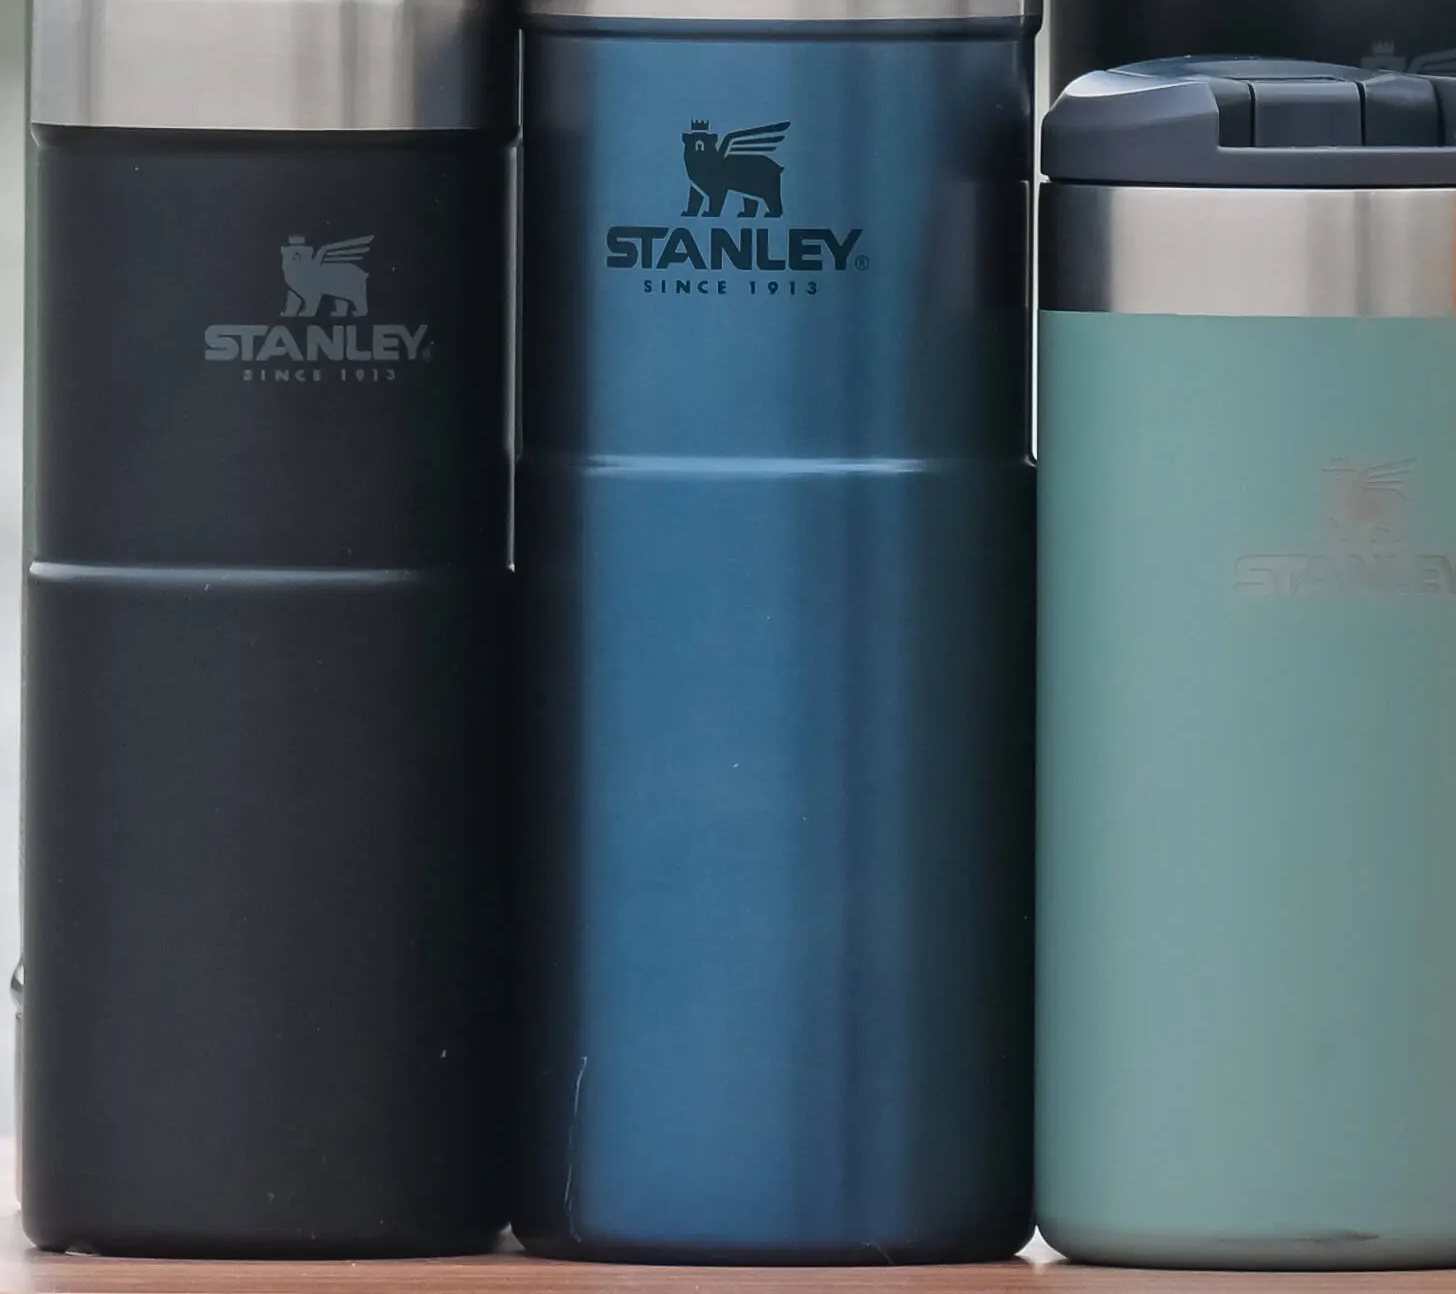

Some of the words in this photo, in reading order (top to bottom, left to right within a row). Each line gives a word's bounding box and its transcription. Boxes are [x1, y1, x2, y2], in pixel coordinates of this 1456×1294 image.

[606, 225, 864, 271] STANLEY
[643, 279, 728, 296] SINCE
[748, 279, 819, 296] 1913
[204, 324, 429, 362] STANLEY
[243, 368, 322, 383] SINCE
